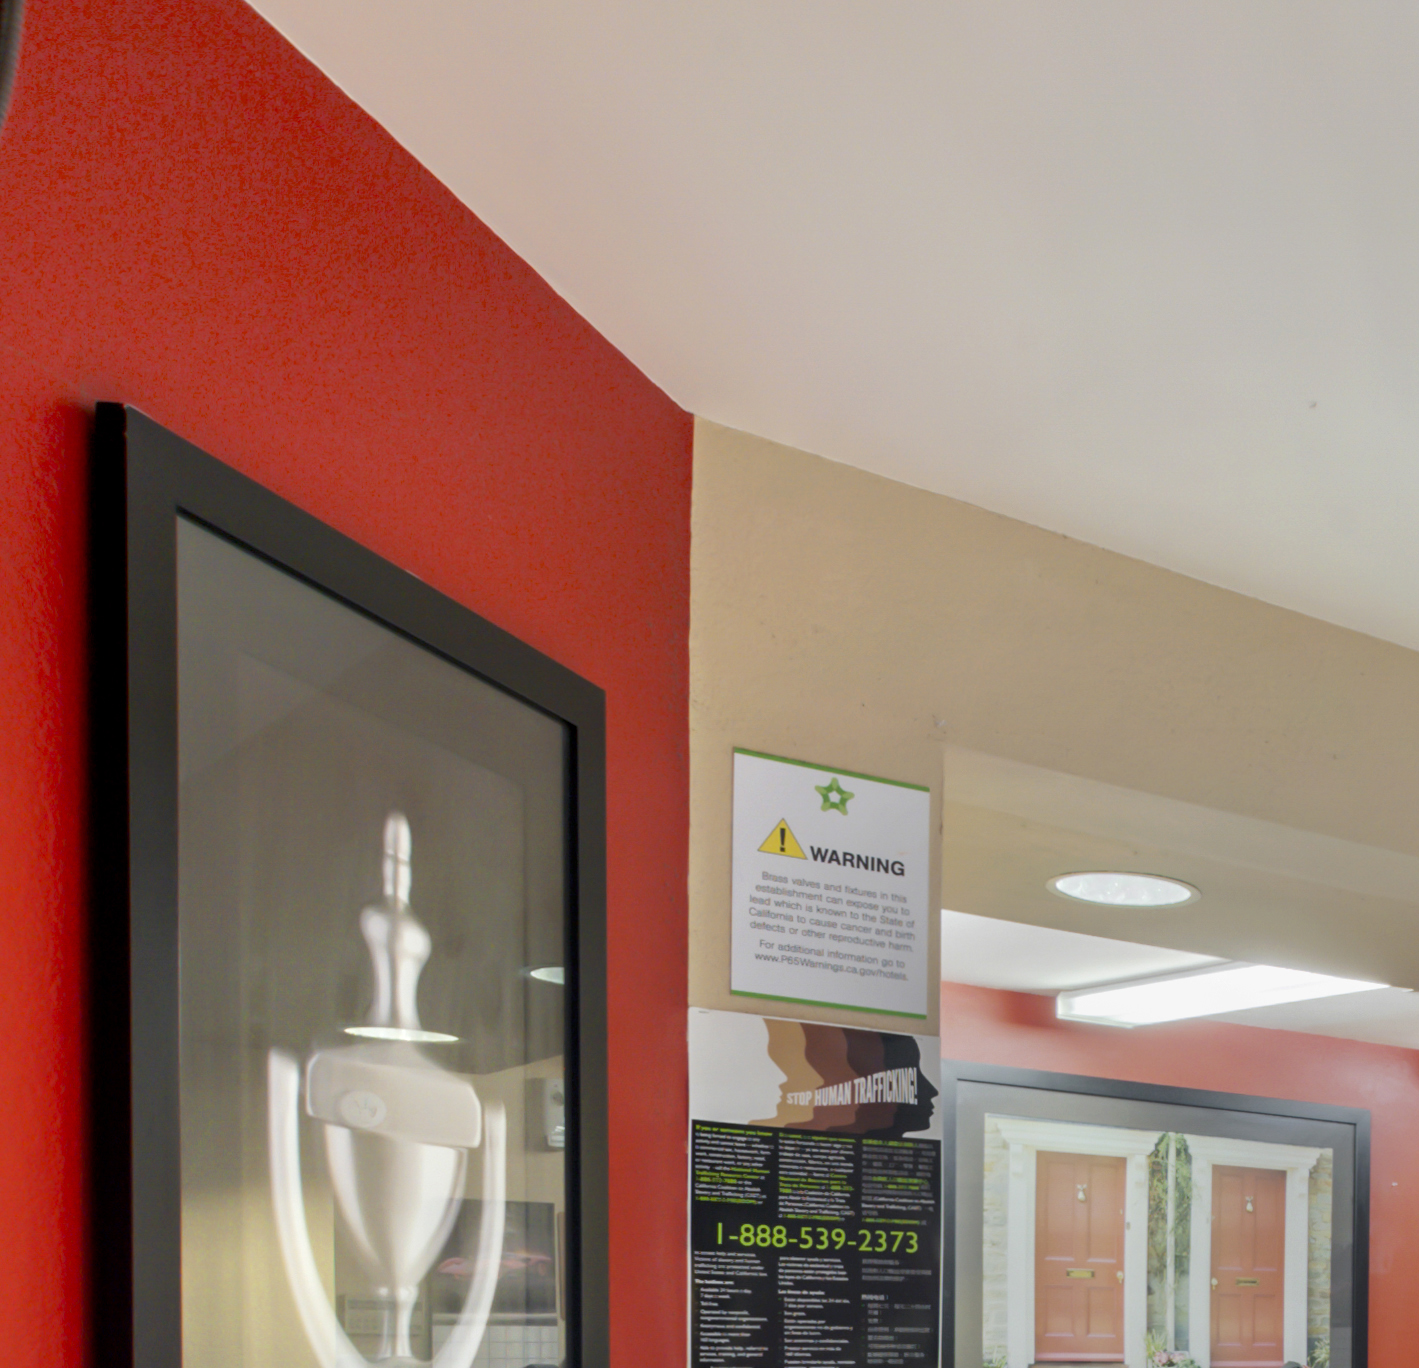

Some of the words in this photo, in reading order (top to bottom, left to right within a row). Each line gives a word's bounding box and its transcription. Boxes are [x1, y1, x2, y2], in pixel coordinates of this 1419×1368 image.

[810, 845, 905, 876] WARNING
[755, 884, 822, 902] establishment
[826, 896, 843, 905] can
[846, 899, 878, 912] expose
[882, 905, 898, 915] you
[901, 907, 910, 916] to
[762, 871, 788, 884] Brass
[792, 877, 820, 889] valves
[824, 883, 841, 892] and
[845, 885, 877, 899] fixtures
[880, 890, 888, 900] in
[891, 893, 907, 903] this
[749, 907, 793, 922] California
[797, 915, 806, 924] to
[809, 918, 838, 928] cause
[841, 922, 872, 934] cancer
[875, 927, 892, 937] and
[895, 930, 915, 941] birth
[750, 894, 770, 906] lead
[774, 900, 802, 910] which
[806, 904, 813, 913] is
[816, 905, 847, 917] known
[850, 911, 859, 920] to
[862, 913, 877, 923] the
[880, 915, 903, 927] State
[906, 920, 915, 929] of
[750, 921, 785, 933] defects
[789, 926, 798, 934] or
[801, 928, 826, 939] other
[829, 933, 885, 949] reproductive
[759, 939, 775, 949] For
[778, 943, 824, 957] additional
[827, 950, 878, 965] information
[881, 959, 893, 968] go
[896, 960, 905, 969] to
[786, 1090, 812, 1106] STOP
[814, 1080, 852, 1107] HUMAN
[853, 1067, 918, 1105] TRAFFICKING!
[716, 1222, 919, 1254] 1-888-539-2373
